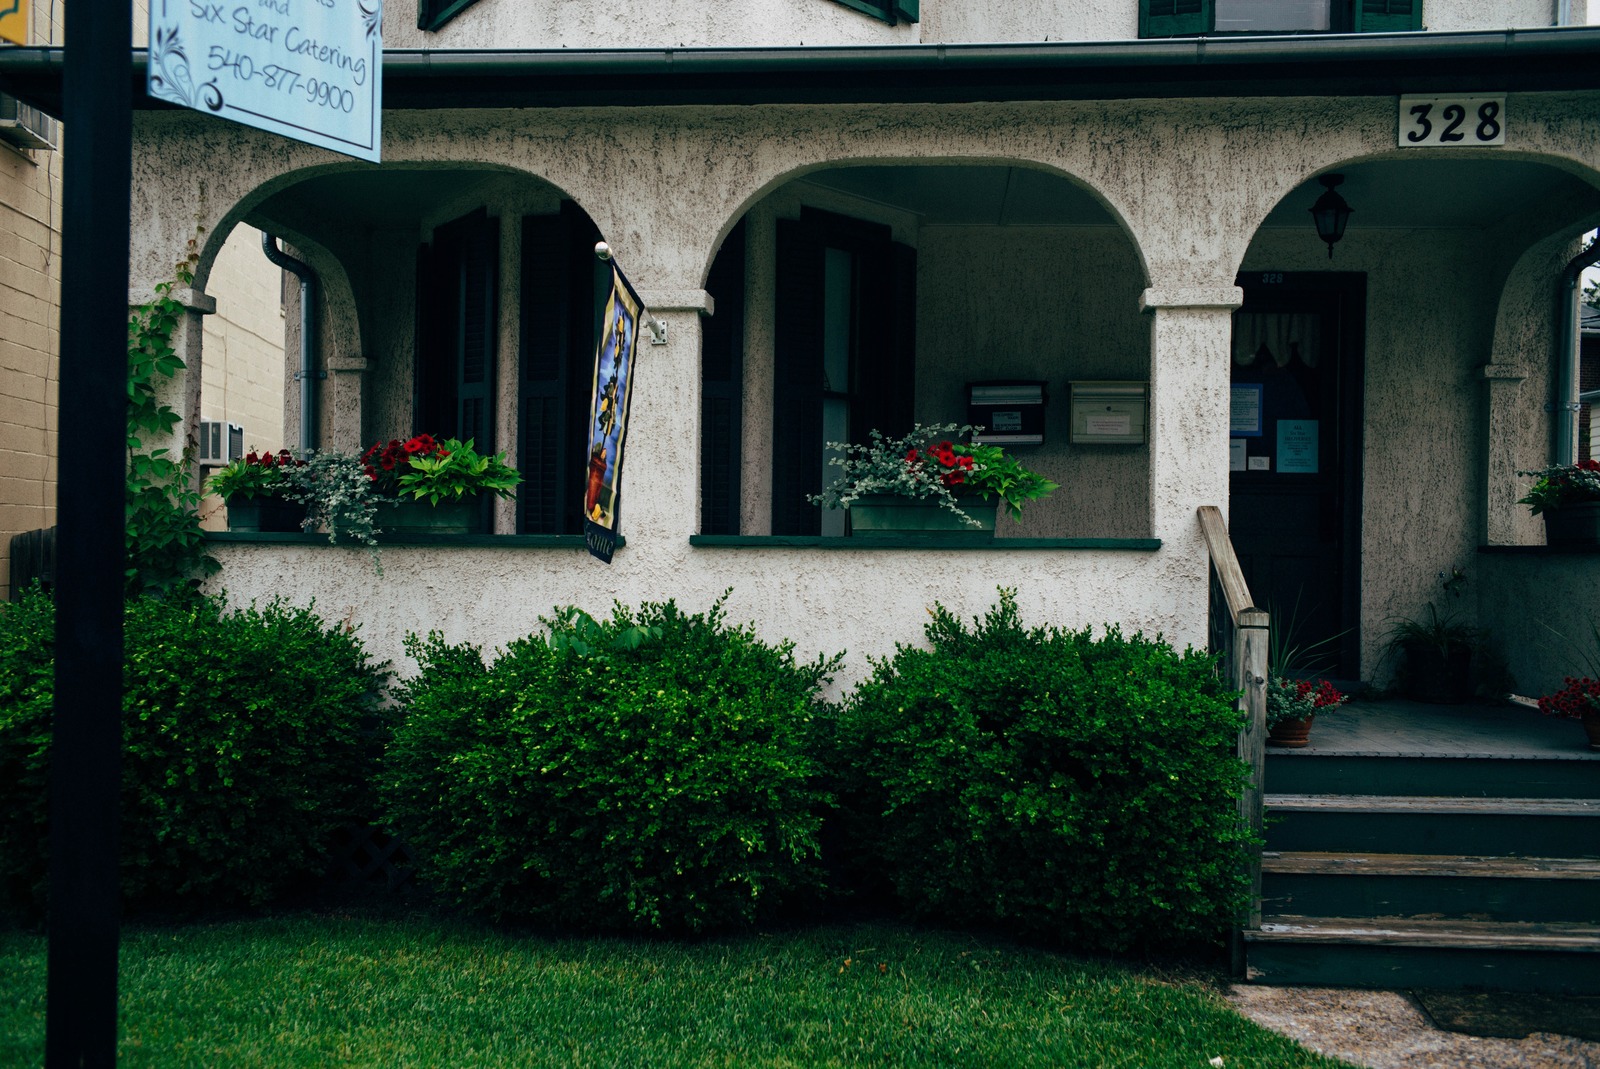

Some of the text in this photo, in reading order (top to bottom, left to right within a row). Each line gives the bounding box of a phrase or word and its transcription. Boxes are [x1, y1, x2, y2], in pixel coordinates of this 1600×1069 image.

[189, 0, 366, 86] Six Star Catering
[206, 45, 354, 113] 540-877-9900
[1407, 101, 1501, 142] 328
[1262, 272, 1284, 284] 328
